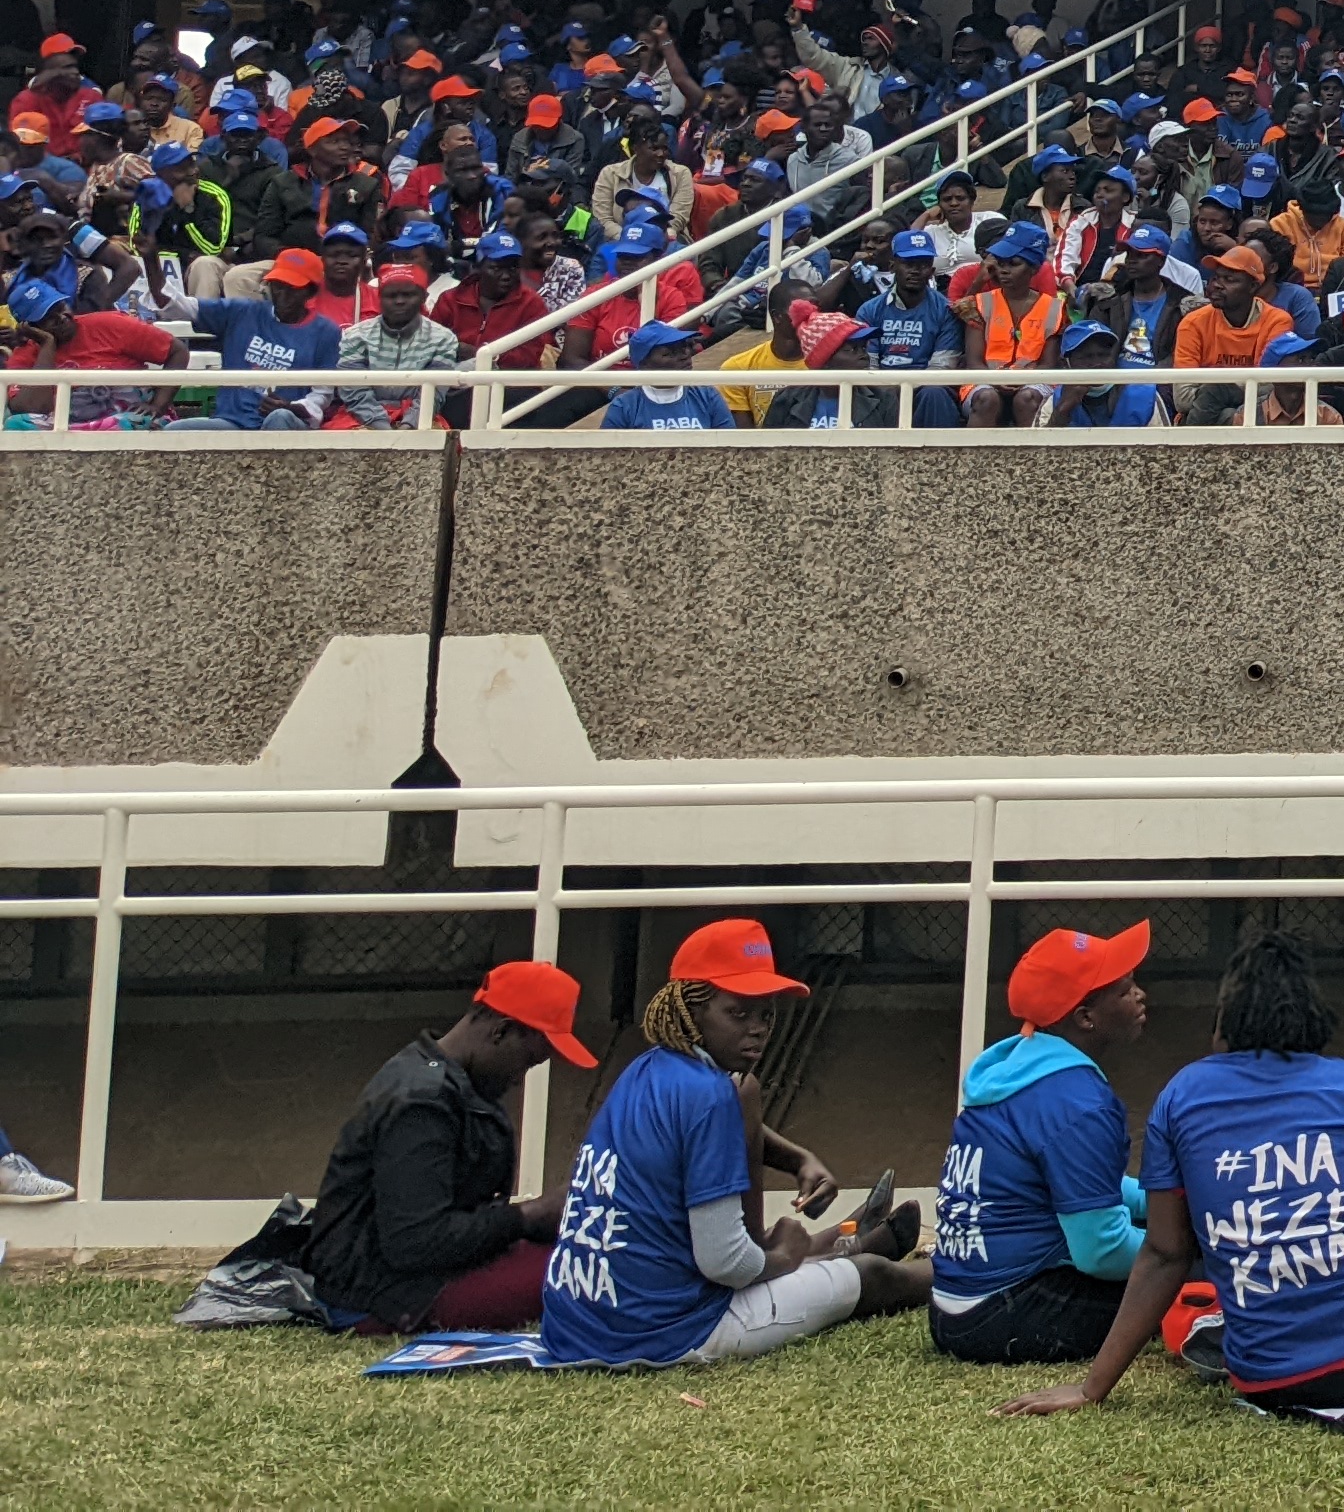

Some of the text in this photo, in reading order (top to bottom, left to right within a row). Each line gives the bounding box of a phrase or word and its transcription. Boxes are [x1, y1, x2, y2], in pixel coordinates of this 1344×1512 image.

[882, 319, 923, 334] BABA
[248, 335, 296, 363] BABA
[881, 336, 921, 347] MARTHA
[652, 416, 704, 430] BABA
[1214, 1132, 1341, 1193] #INA
